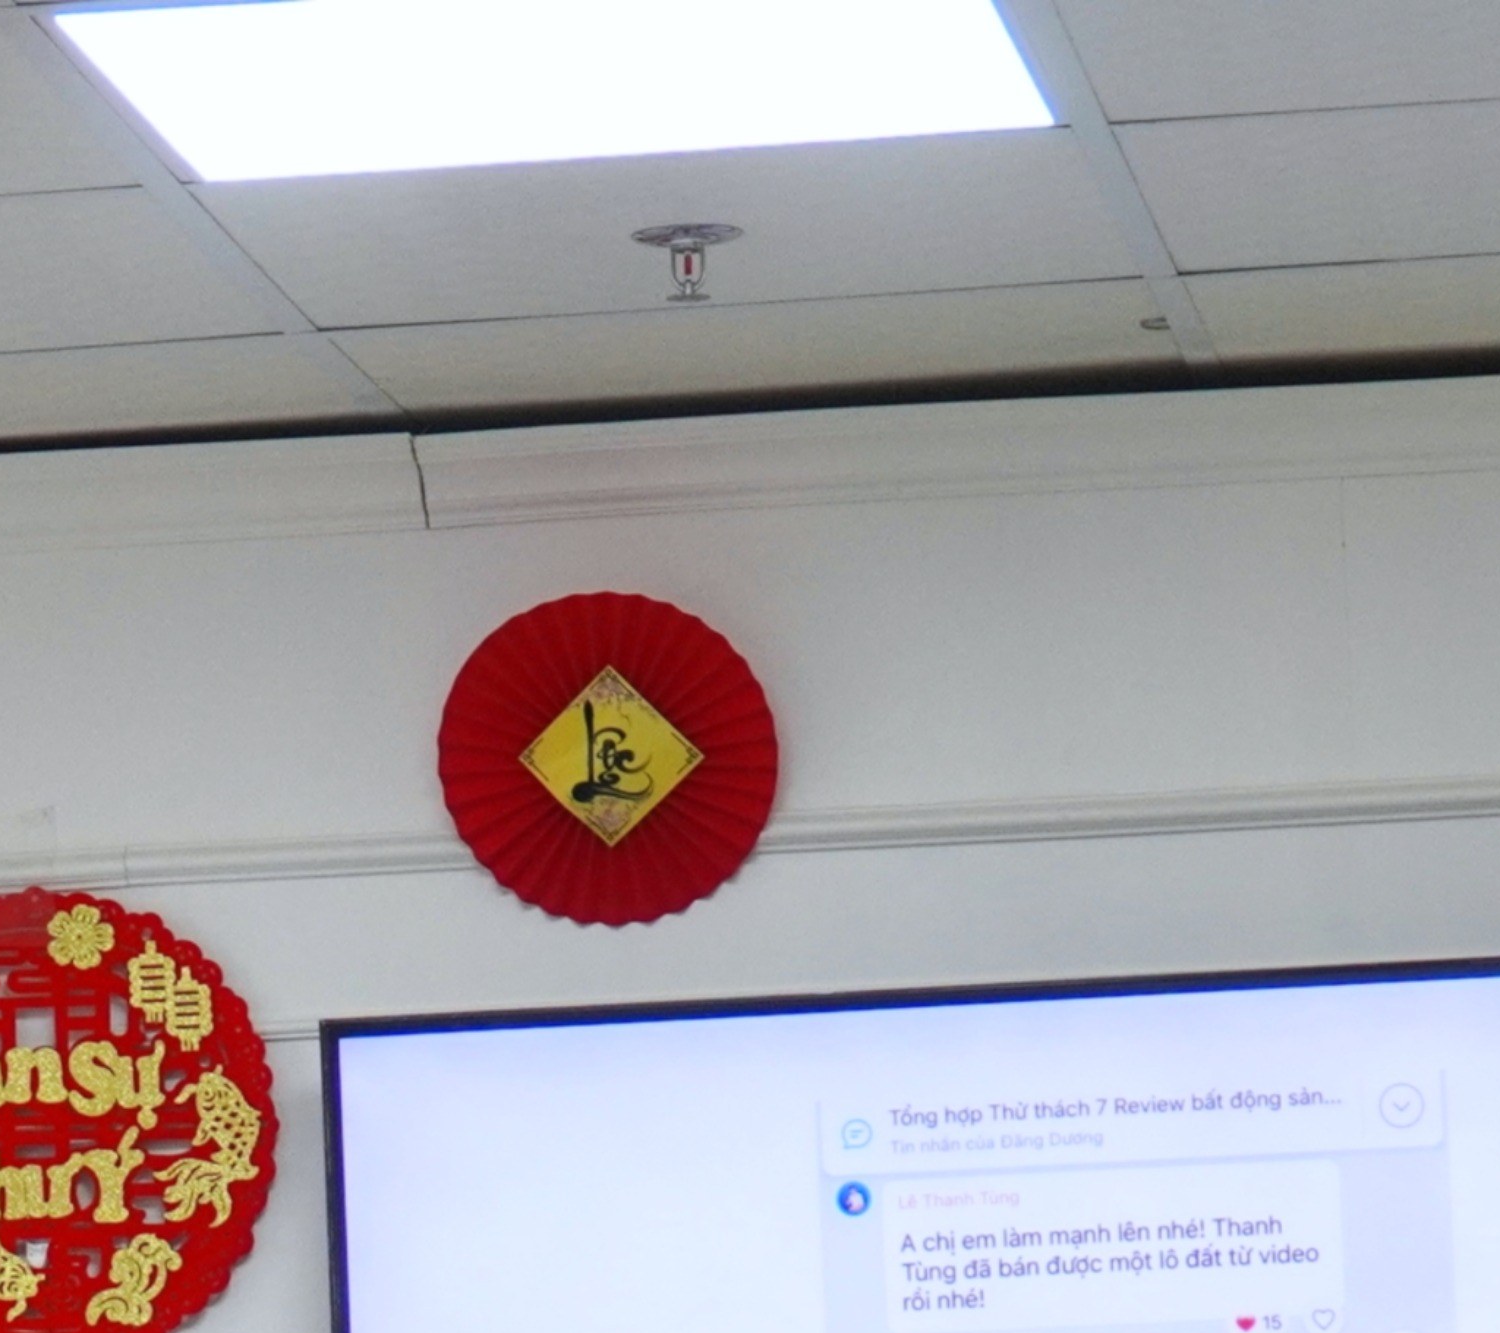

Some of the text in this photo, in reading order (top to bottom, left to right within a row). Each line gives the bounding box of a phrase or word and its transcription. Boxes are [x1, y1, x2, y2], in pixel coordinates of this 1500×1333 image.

[888, 1103, 939, 1130] Tổng
[943, 1106, 984, 1128] hợp
[988, 1101, 1030, 1121] Thử
[1033, 1099, 1091, 1120] thách
[1095, 1097, 1109, 1116] 7
[1113, 1095, 1186, 1115] Review
[1190, 1088, 1224, 1112] bất
[1229, 1089, 1283, 1113] động
[889, 1138, 916, 1155] Tin
[900, 1215, 1283, 1256] A chị em làm mạnh lên nhé! Thanh
[901, 1243, 1320, 1286] Tùng đã bán được một lô đất từ video
[902, 1287, 985, 1312] rồi nhé!
[1262, 1313, 1283, 1331] 15
